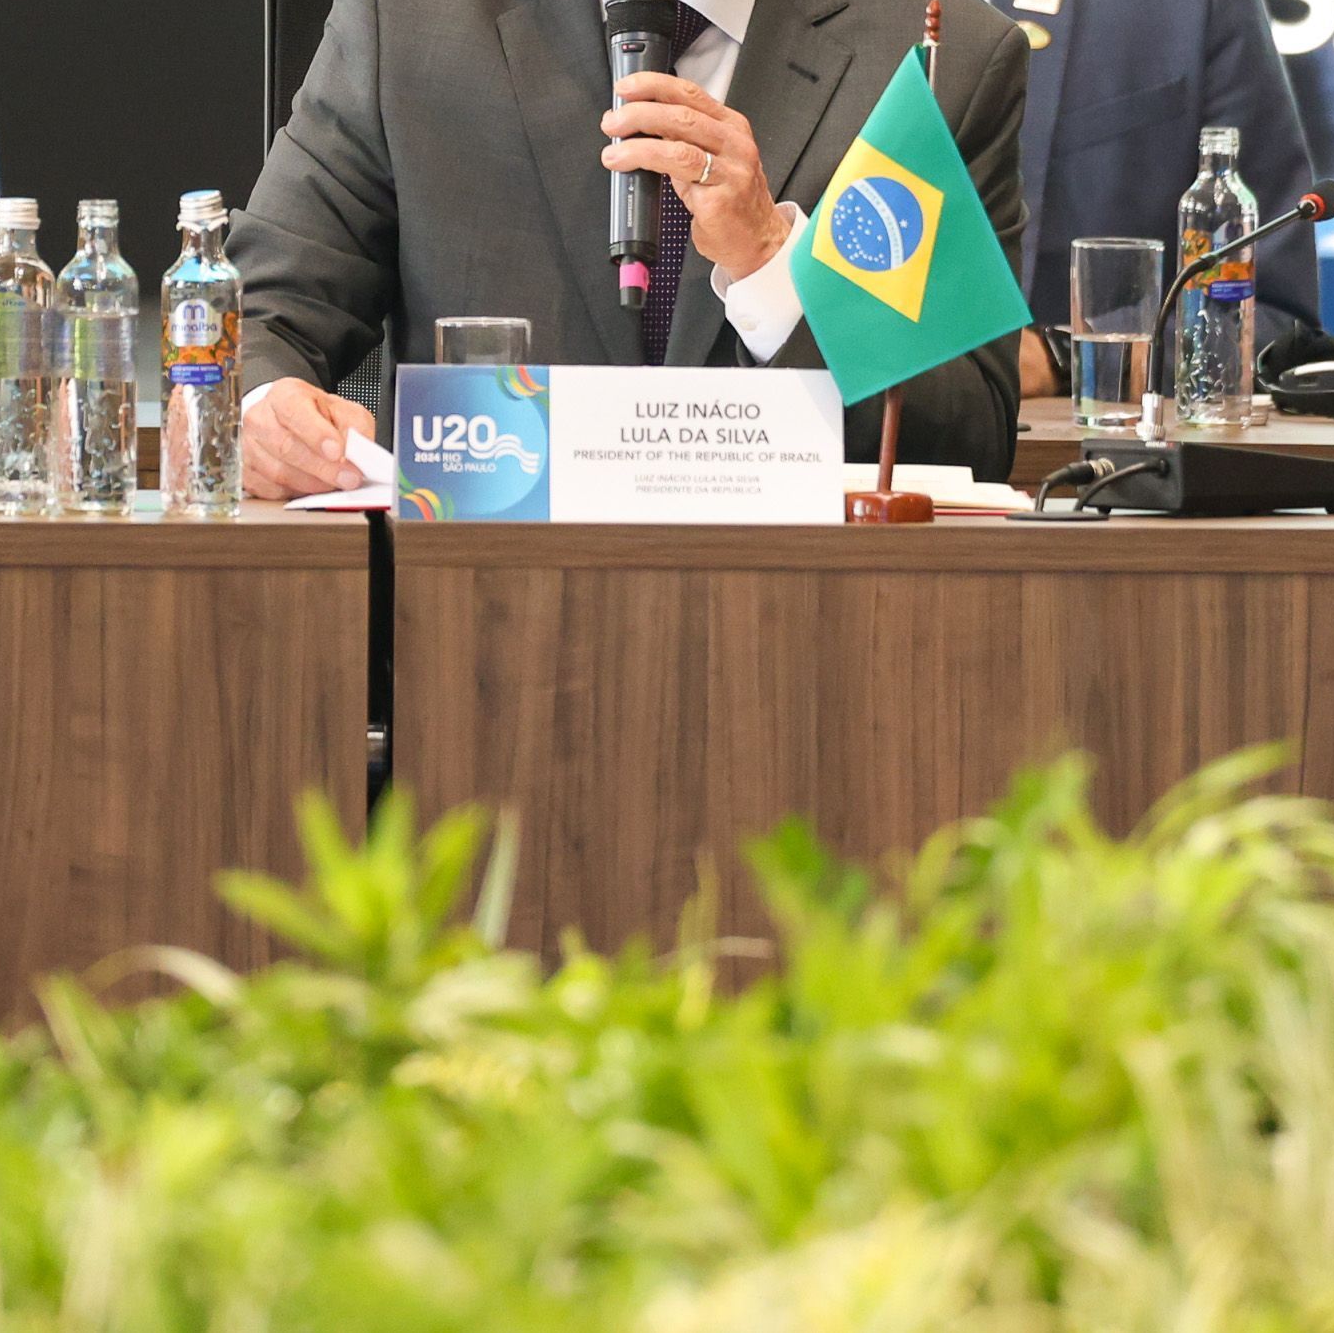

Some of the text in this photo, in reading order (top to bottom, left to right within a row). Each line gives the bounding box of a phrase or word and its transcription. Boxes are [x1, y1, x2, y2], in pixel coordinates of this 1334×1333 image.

[635, 400, 761, 420] LUIZ INÁCIO
[412, 414, 497, 451] U20
[620, 427, 770, 445] LULA DA SILVA
[442, 452, 461, 462] RIO
[573, 450, 822, 463] PRESIDENT OF THE REPUBLIC OF BRAZIL
